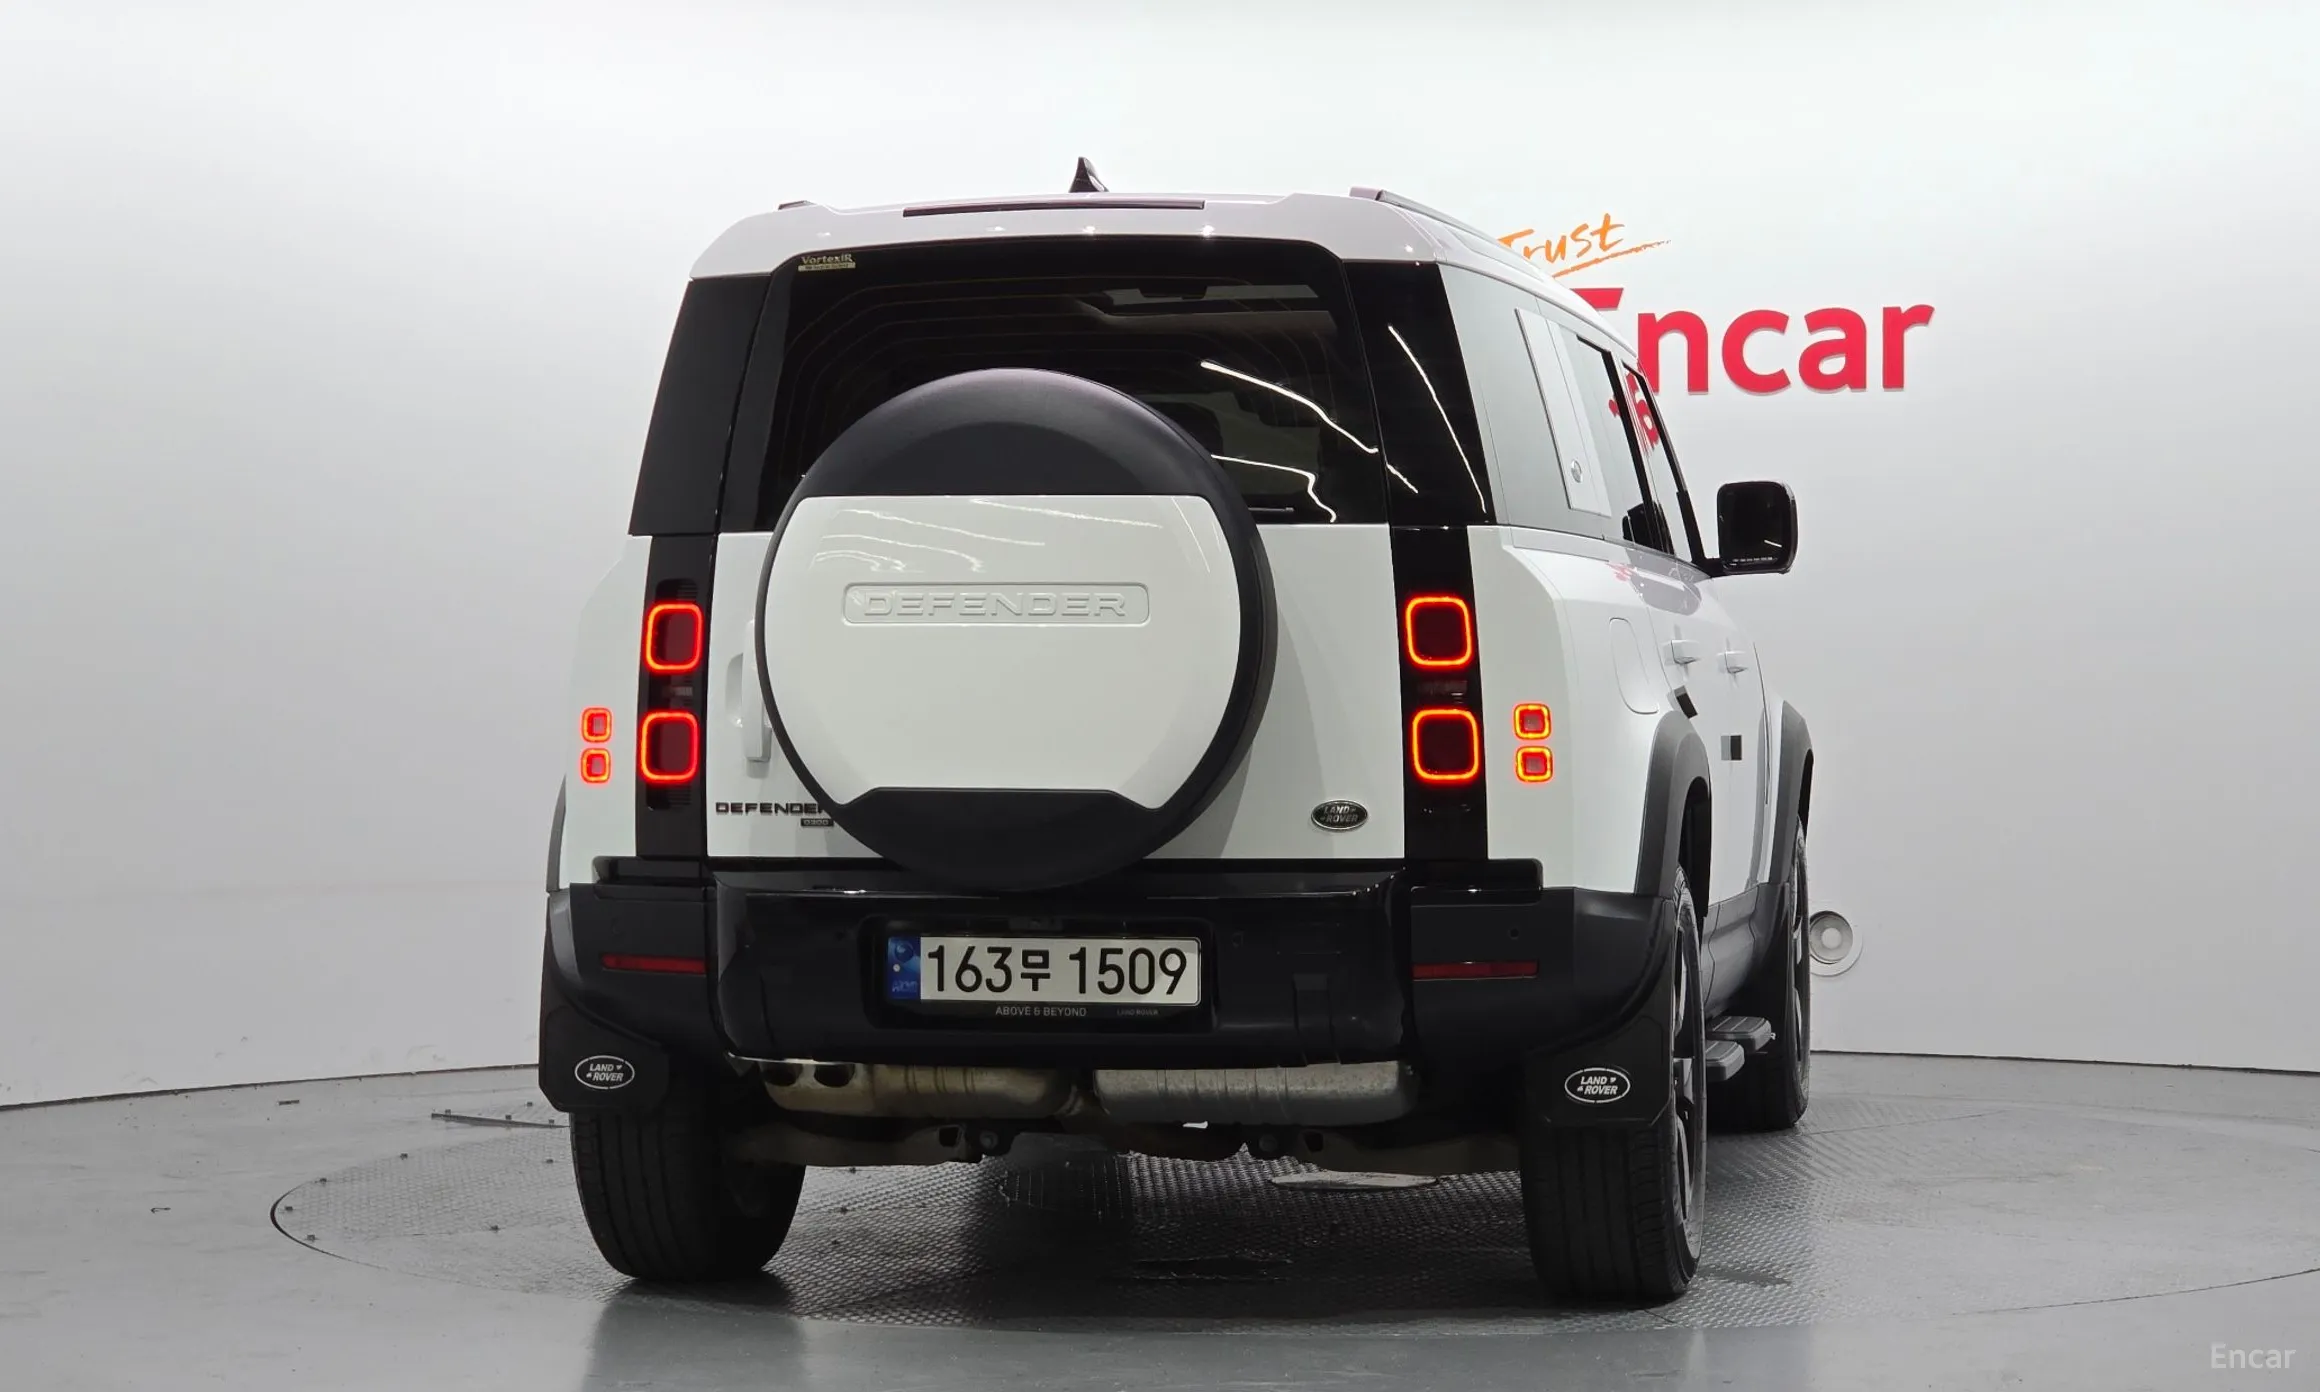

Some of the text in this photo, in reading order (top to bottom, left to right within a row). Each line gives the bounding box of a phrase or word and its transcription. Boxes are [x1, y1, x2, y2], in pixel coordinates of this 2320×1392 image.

[1569, 287, 1935, 396] ncar
[864, 592, 1126, 616] DEFENDER
[1324, 805, 1350, 814] LAND
[1326, 814, 1359, 823] ROVER
[927, 944, 1188, 995] 163무 1509
[995, 1006, 1087, 1017] ABOVE & BEYOND
[589, 1063, 615, 1072] LAND
[592, 1072, 624, 1082] ROVER
[1580, 1076, 1608, 1085] LAND
[1584, 1085, 1618, 1095] ROVER
